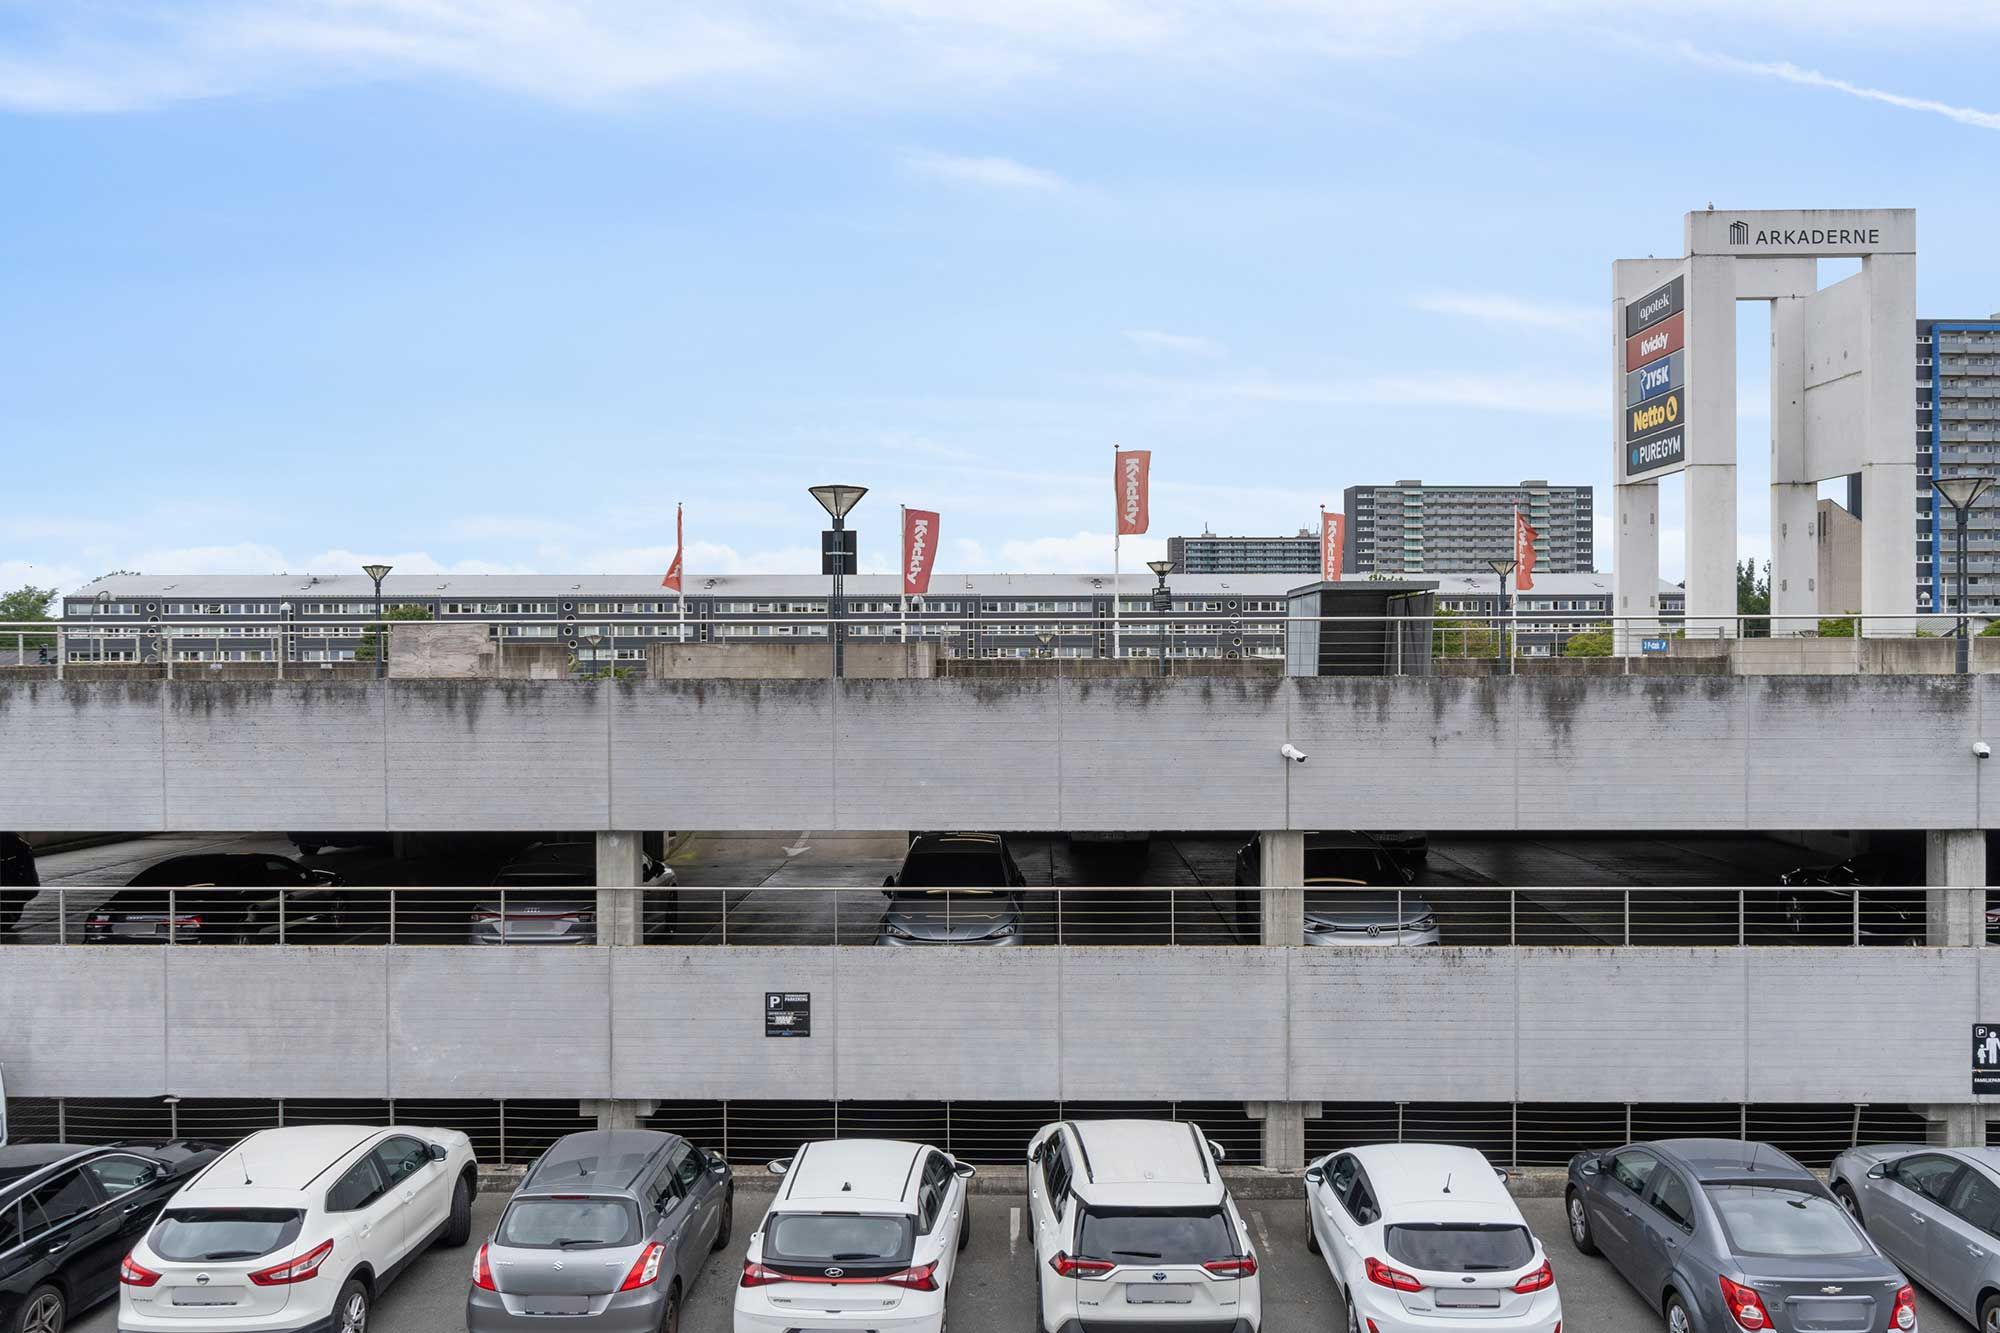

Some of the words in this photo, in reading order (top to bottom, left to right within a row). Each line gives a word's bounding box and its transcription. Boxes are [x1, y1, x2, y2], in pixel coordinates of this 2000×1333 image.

[1755, 229, 1879, 245] ARKADERNE
[1640, 293, 1670, 321] apotek
[1640, 331, 1669, 357] Kvickly
[1645, 365, 1669, 390] JYSK
[1633, 405, 1665, 433] Netto
[1639, 434, 1681, 464] PUREGYM
[1124, 458, 1140, 525] Kvickly
[907, 519, 929, 585] Kvickly
[770, 996, 780, 1008] P
